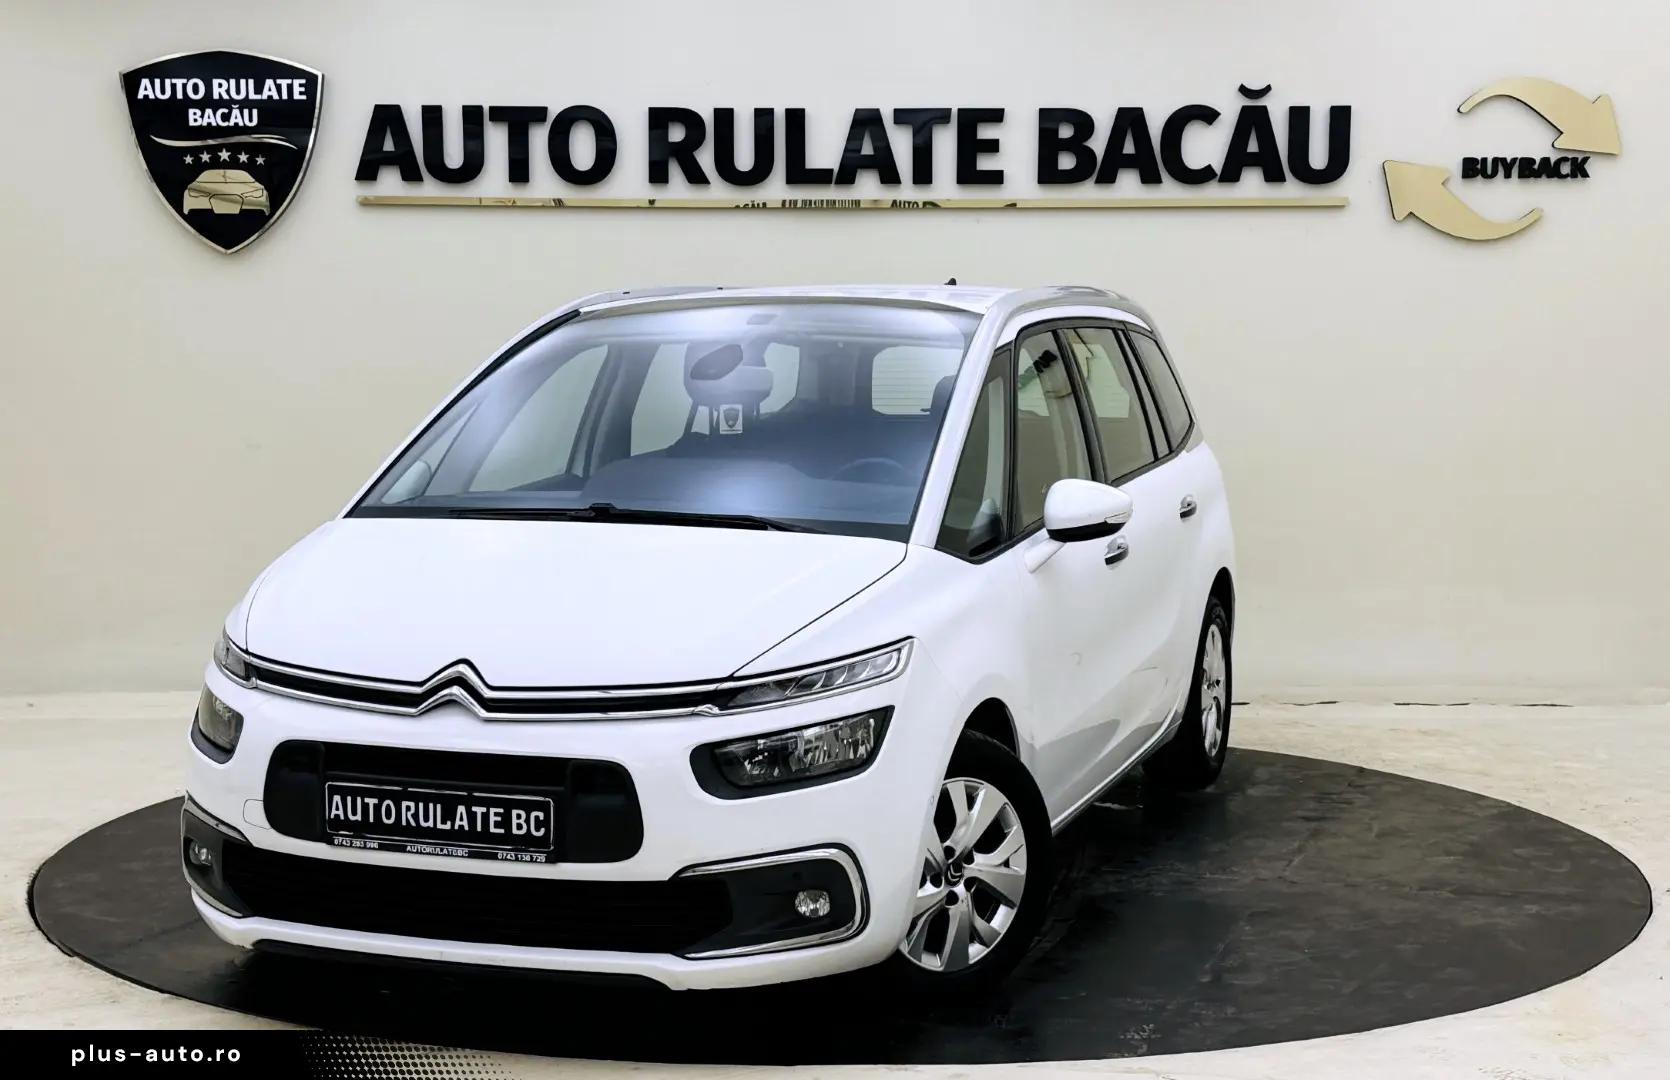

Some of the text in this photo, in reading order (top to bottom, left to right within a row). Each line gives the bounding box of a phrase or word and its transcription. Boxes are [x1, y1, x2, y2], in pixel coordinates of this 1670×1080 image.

[137, 77, 307, 100] AUTO RULATE
[188, 105, 258, 127] BACĂU
[355, 83, 1352, 188] AUTO RULATE BACĂU
[1461, 155, 1591, 180] BUYBACK
[330, 794, 546, 837] AUTO RULATE BC
